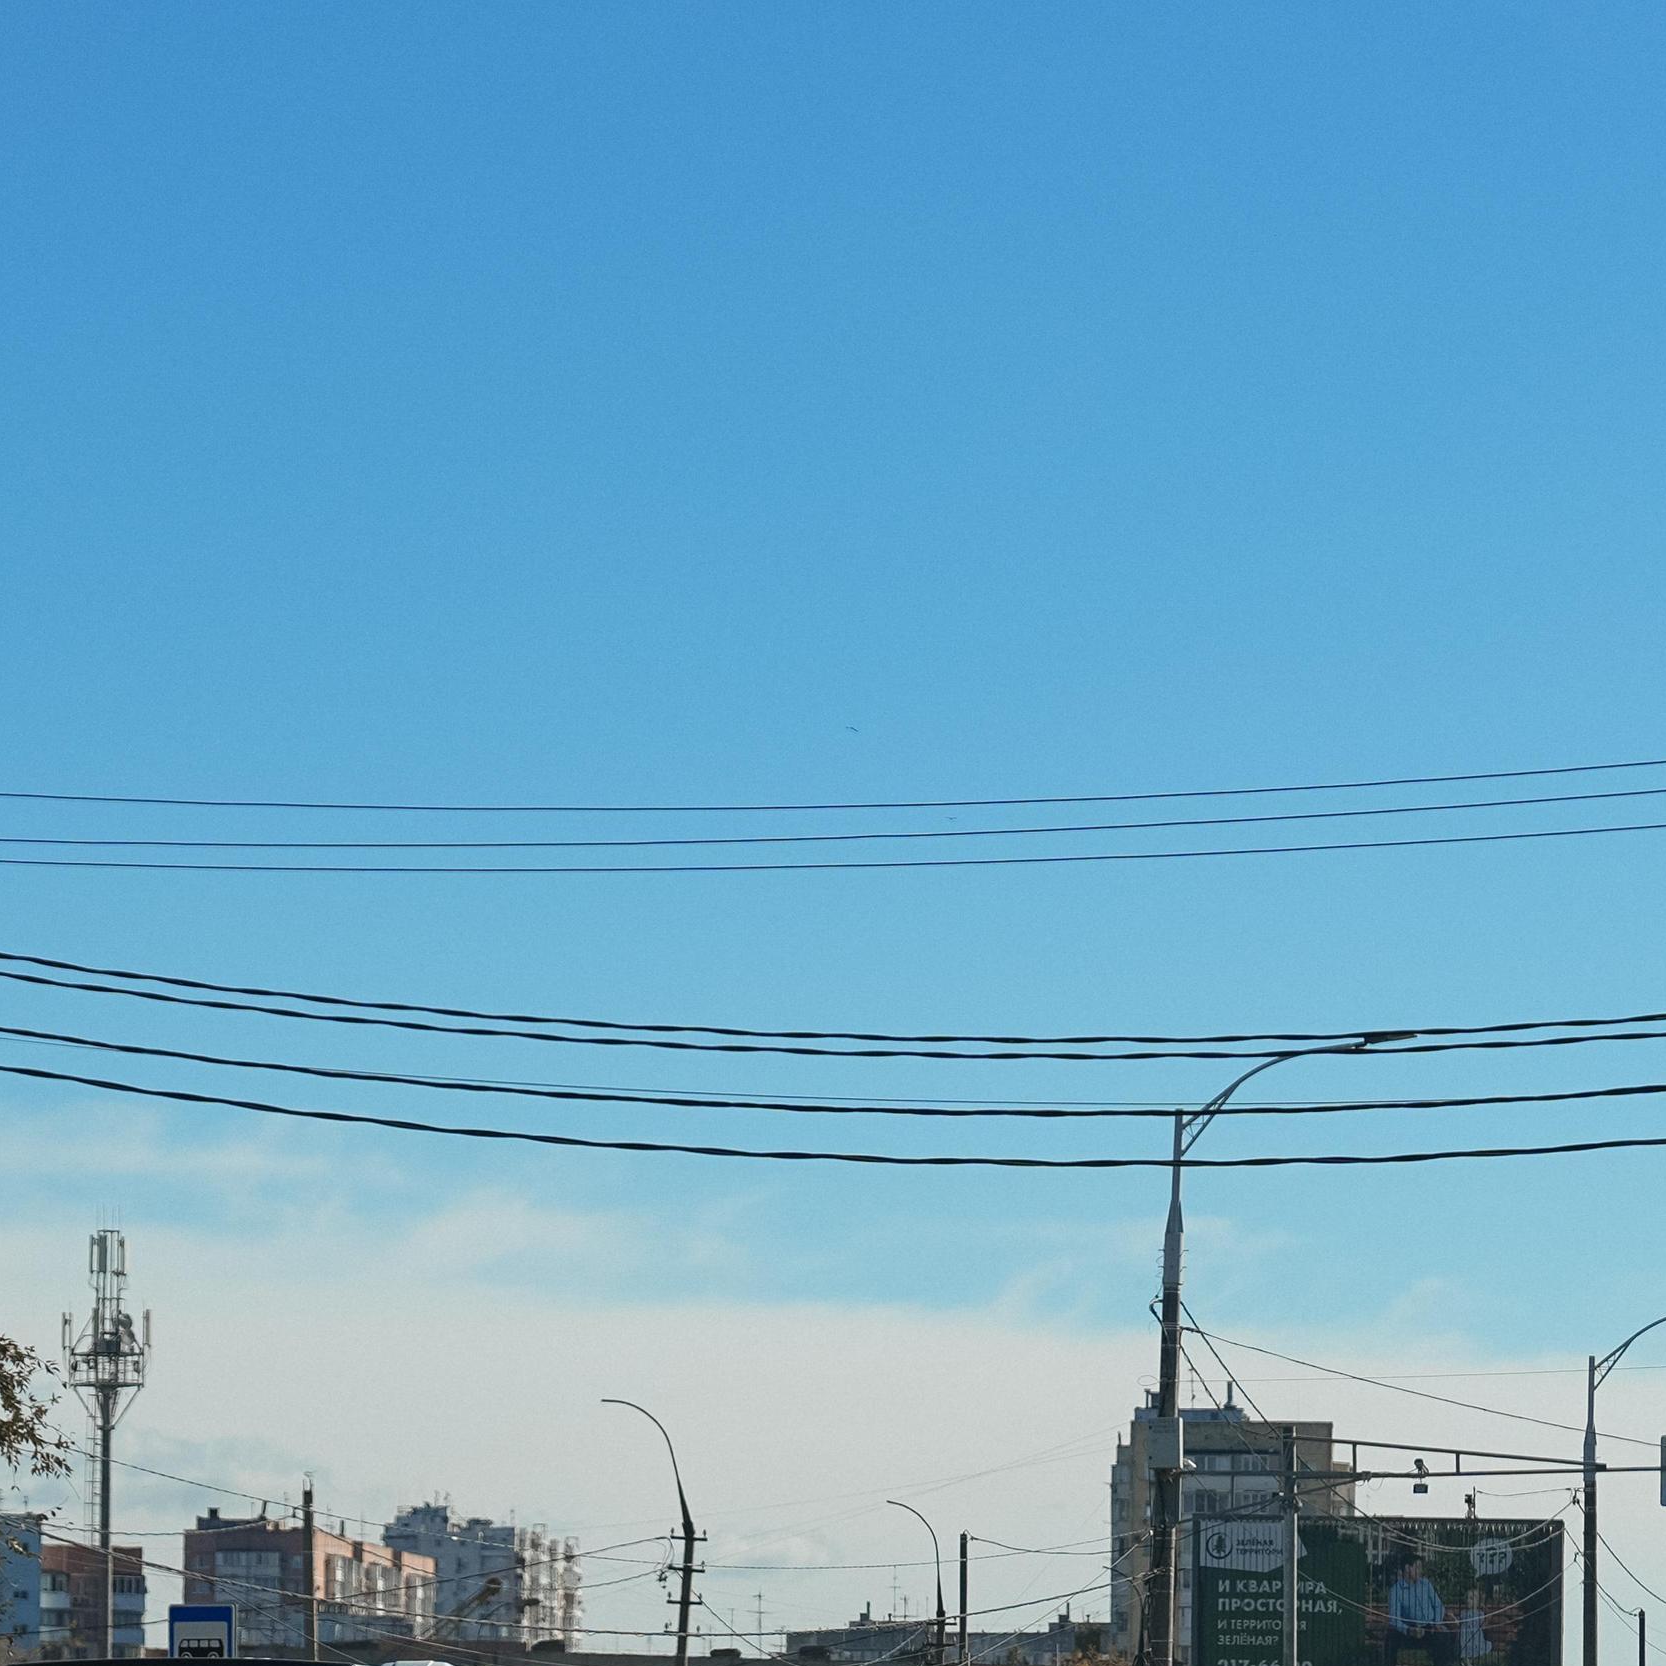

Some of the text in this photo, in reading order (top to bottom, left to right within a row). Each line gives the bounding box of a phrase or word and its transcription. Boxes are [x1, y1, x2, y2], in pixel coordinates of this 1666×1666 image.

[1218, 1580, 1327, 1594] И КВАРИРА
[1217, 1598, 1343, 1614] ПРОСТОНАЯ,
[1217, 1619, 1307, 1631] И ТЕРРИТОЯ
[1217, 1633, 1279, 1645] ЗЕЛЁНАЯ?
